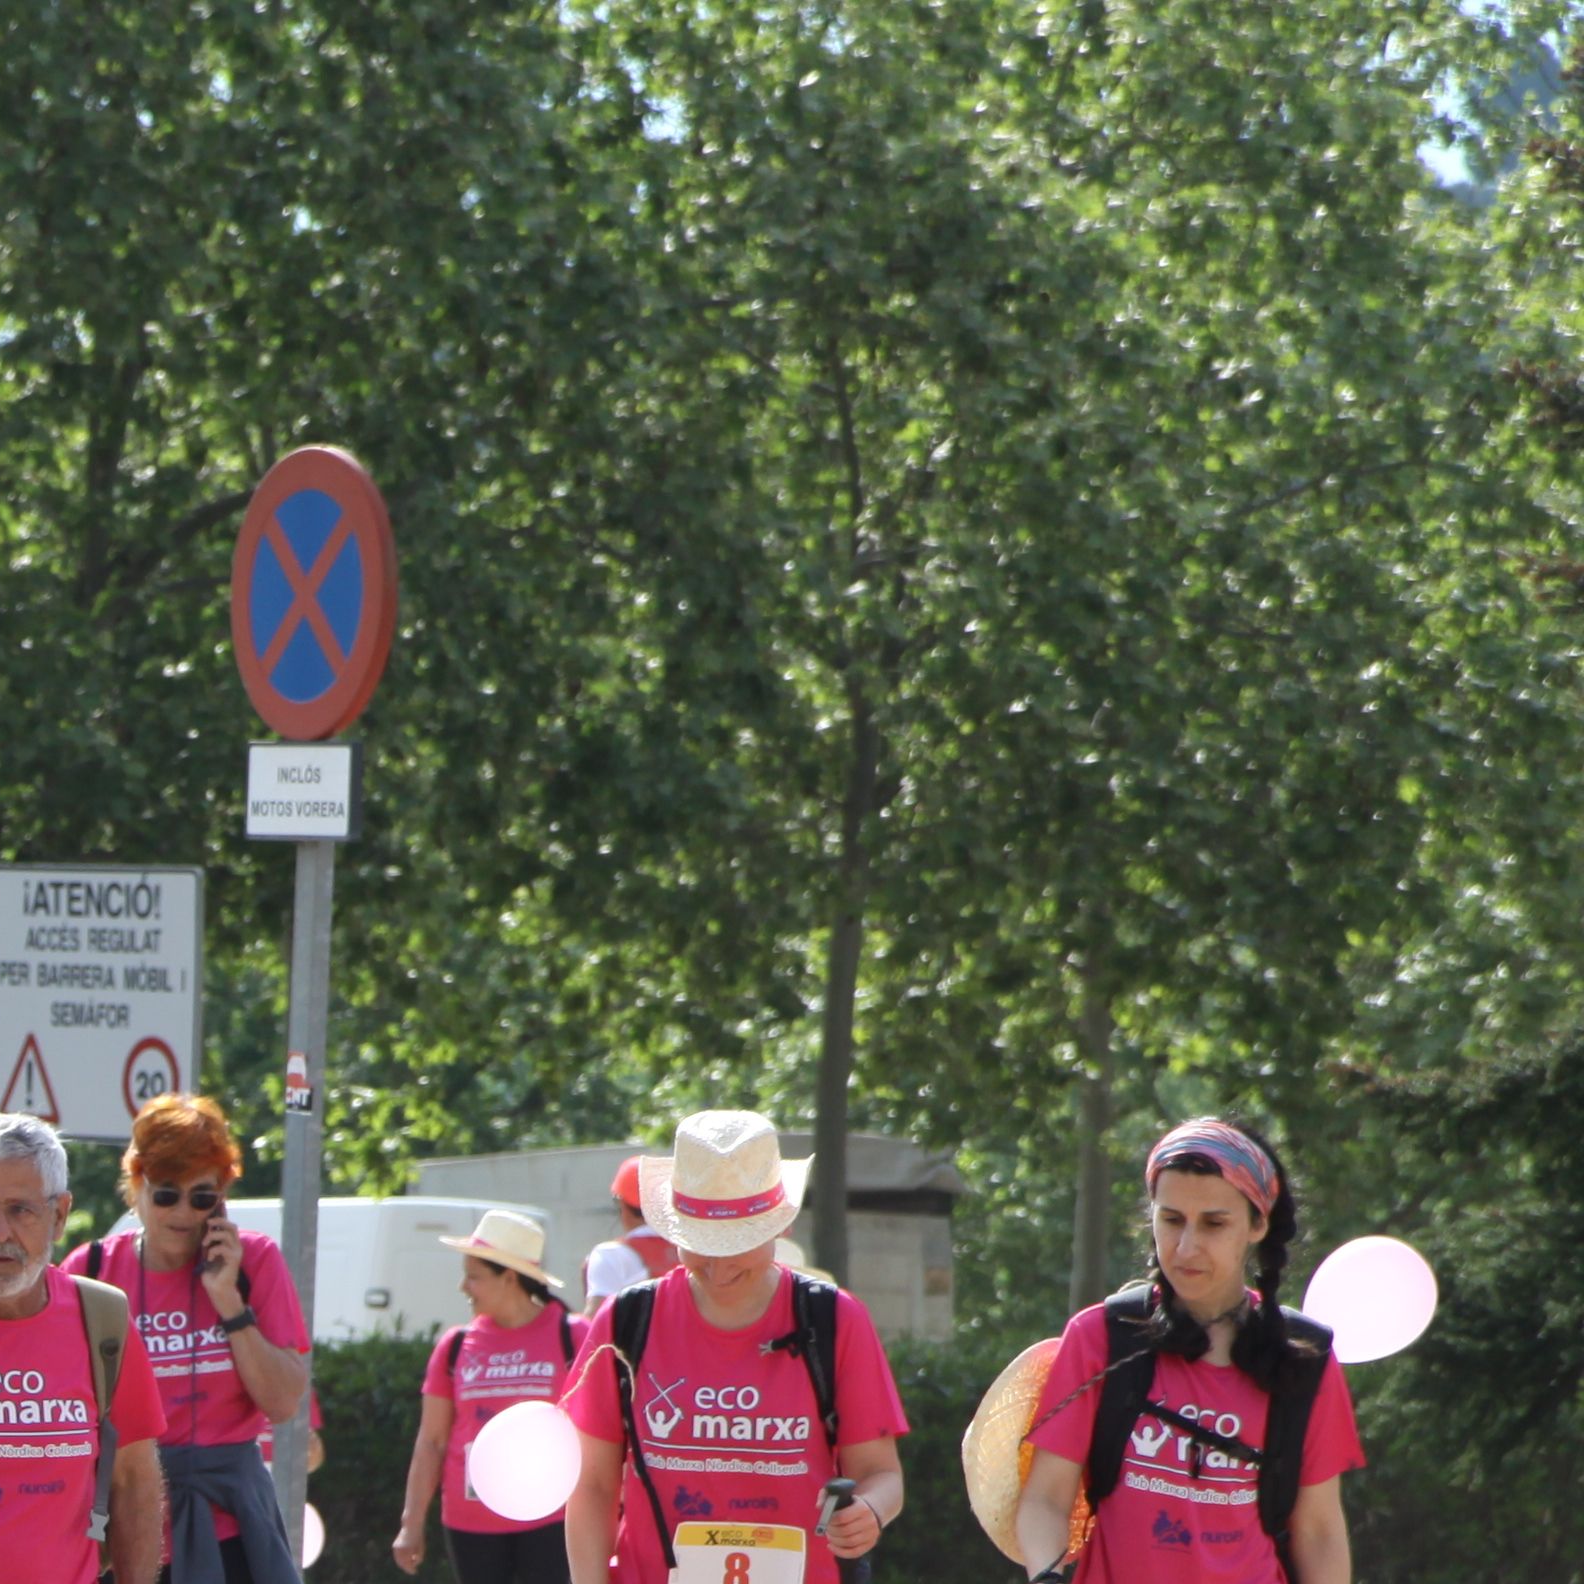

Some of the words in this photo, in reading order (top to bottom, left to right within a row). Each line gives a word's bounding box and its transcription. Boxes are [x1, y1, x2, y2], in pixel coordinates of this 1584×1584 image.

[250, 801, 293, 817] MOTOS
[297, 801, 345, 818] VORERA
[22, 872, 162, 920] ¡ATENCIÓ!
[88, 928, 161, 953] REGULAT
[37, 961, 115, 991] BARRERA
[136, 1073, 166, 1101] 20
[136, 1311, 187, 1332] eco
[488, 1350, 525, 1364] eco
[485, 1362, 555, 1379] marxa
[694, 1385, 760, 1410] eco
[692, 1414, 810, 1441] marxa
[667, 1457, 704, 1471] Marxa
[720, 1538, 756, 1546] marxa
